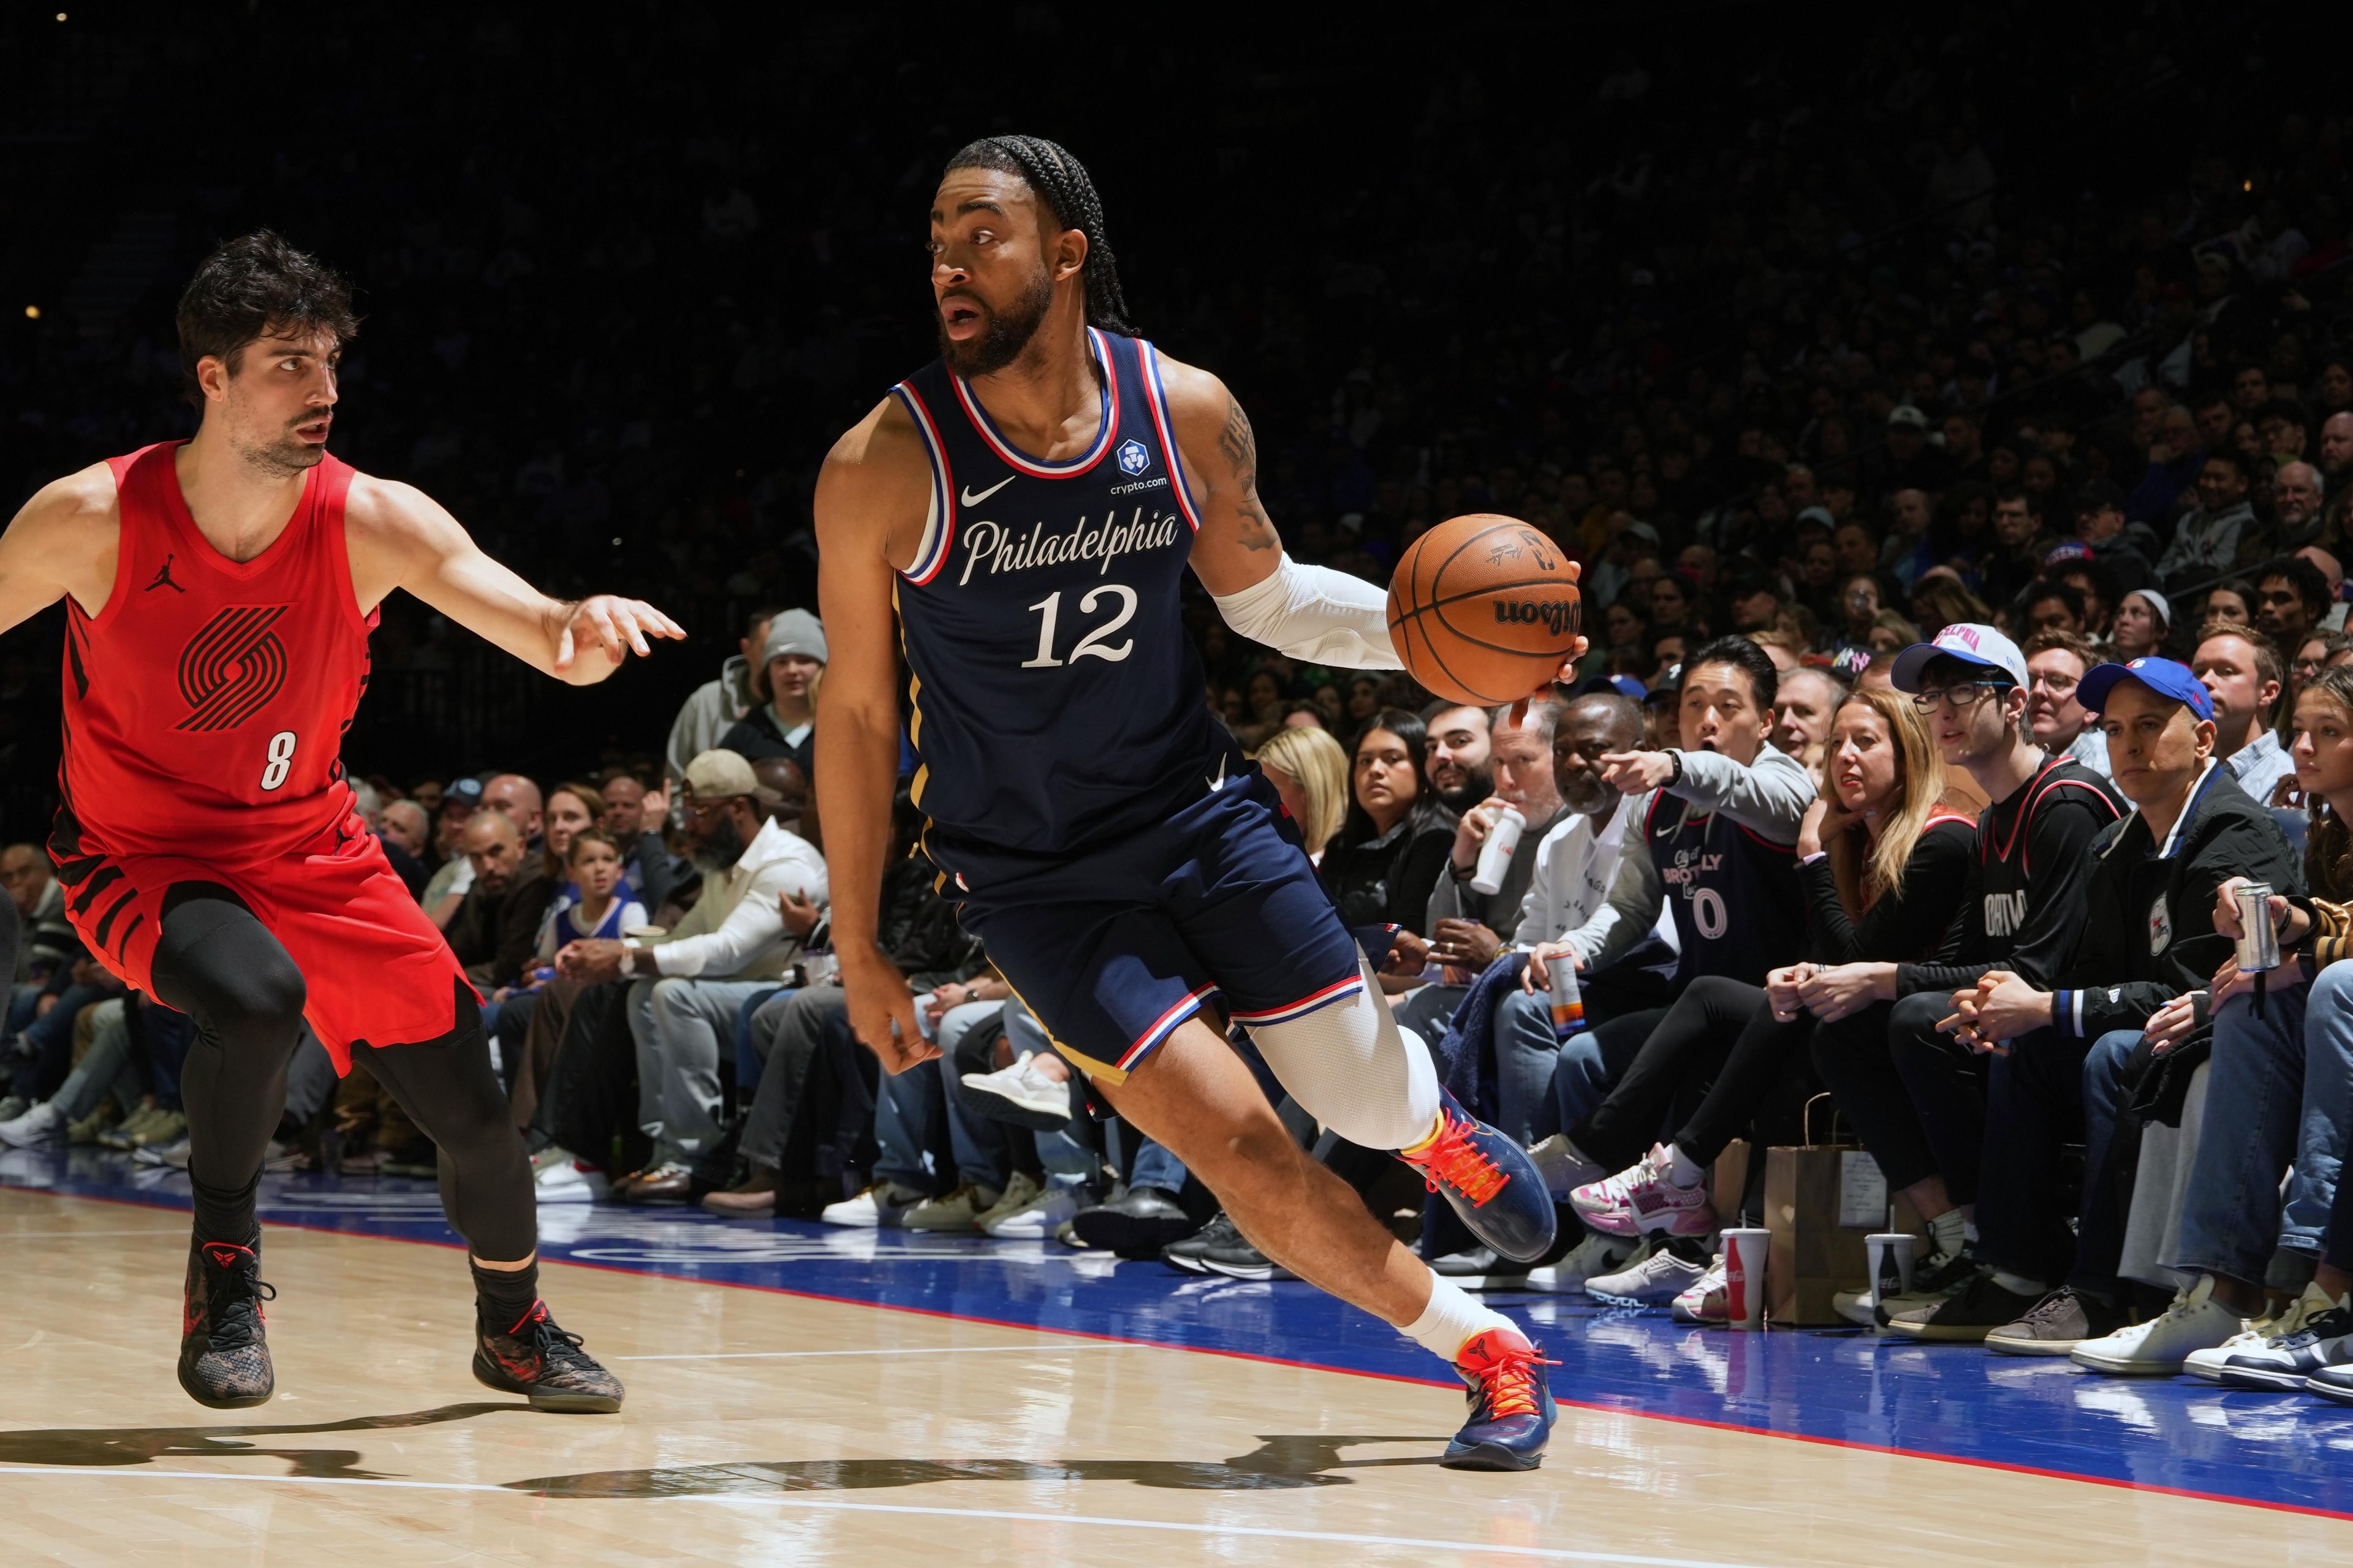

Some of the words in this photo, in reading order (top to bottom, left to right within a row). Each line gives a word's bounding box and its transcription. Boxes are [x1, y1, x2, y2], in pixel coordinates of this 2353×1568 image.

[1110, 477, 1167, 494] crypto.com
[958, 506, 1176, 586] Philadelphia
[1021, 585, 1137, 668] 12
[1494, 600, 1581, 636] Wilson
[260, 731, 298, 791] 8
[1693, 887, 1728, 940] 0
